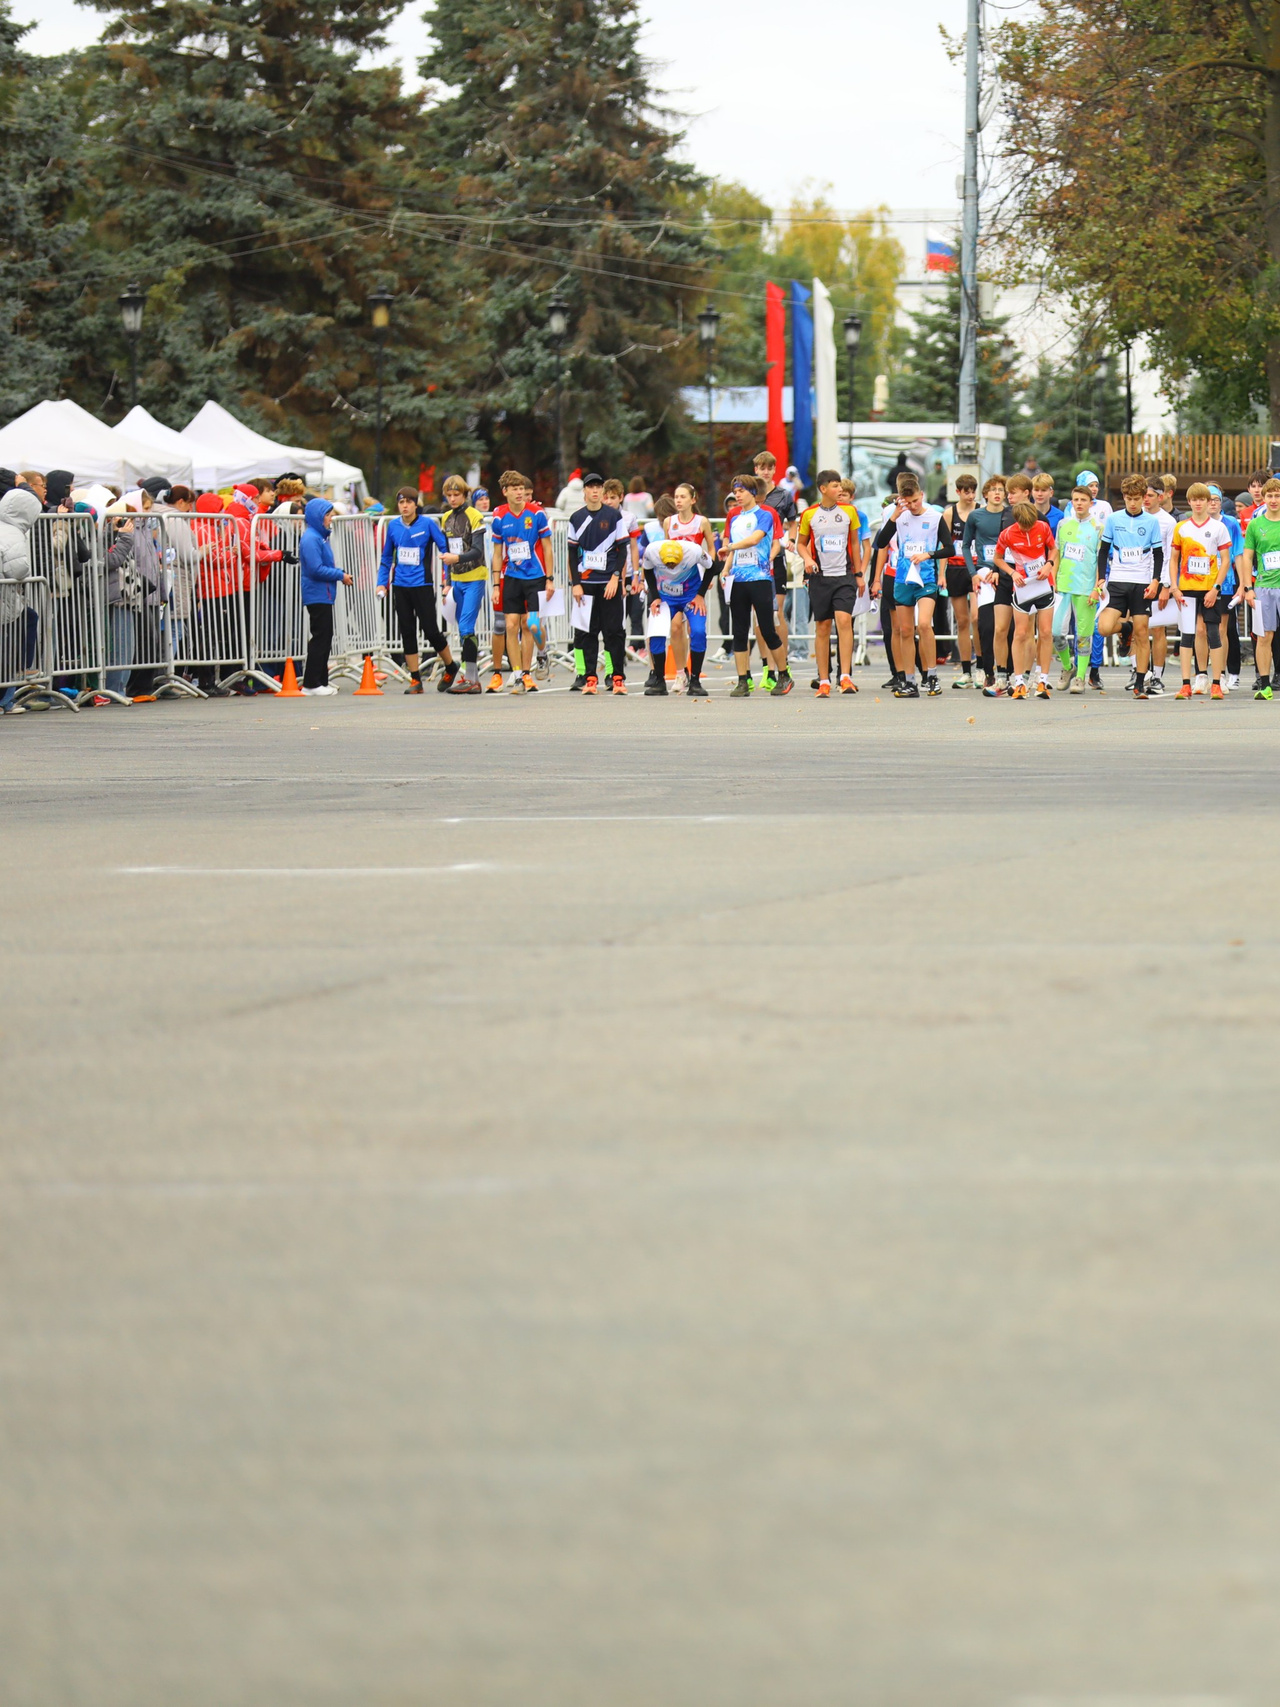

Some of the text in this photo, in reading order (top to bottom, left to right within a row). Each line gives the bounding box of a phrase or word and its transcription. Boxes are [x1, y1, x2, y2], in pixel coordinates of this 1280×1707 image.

[738, 551, 753, 559] 305.1
[1122, 549, 1140, 557] 310.1
[1190, 560, 1207, 568] 311.1
